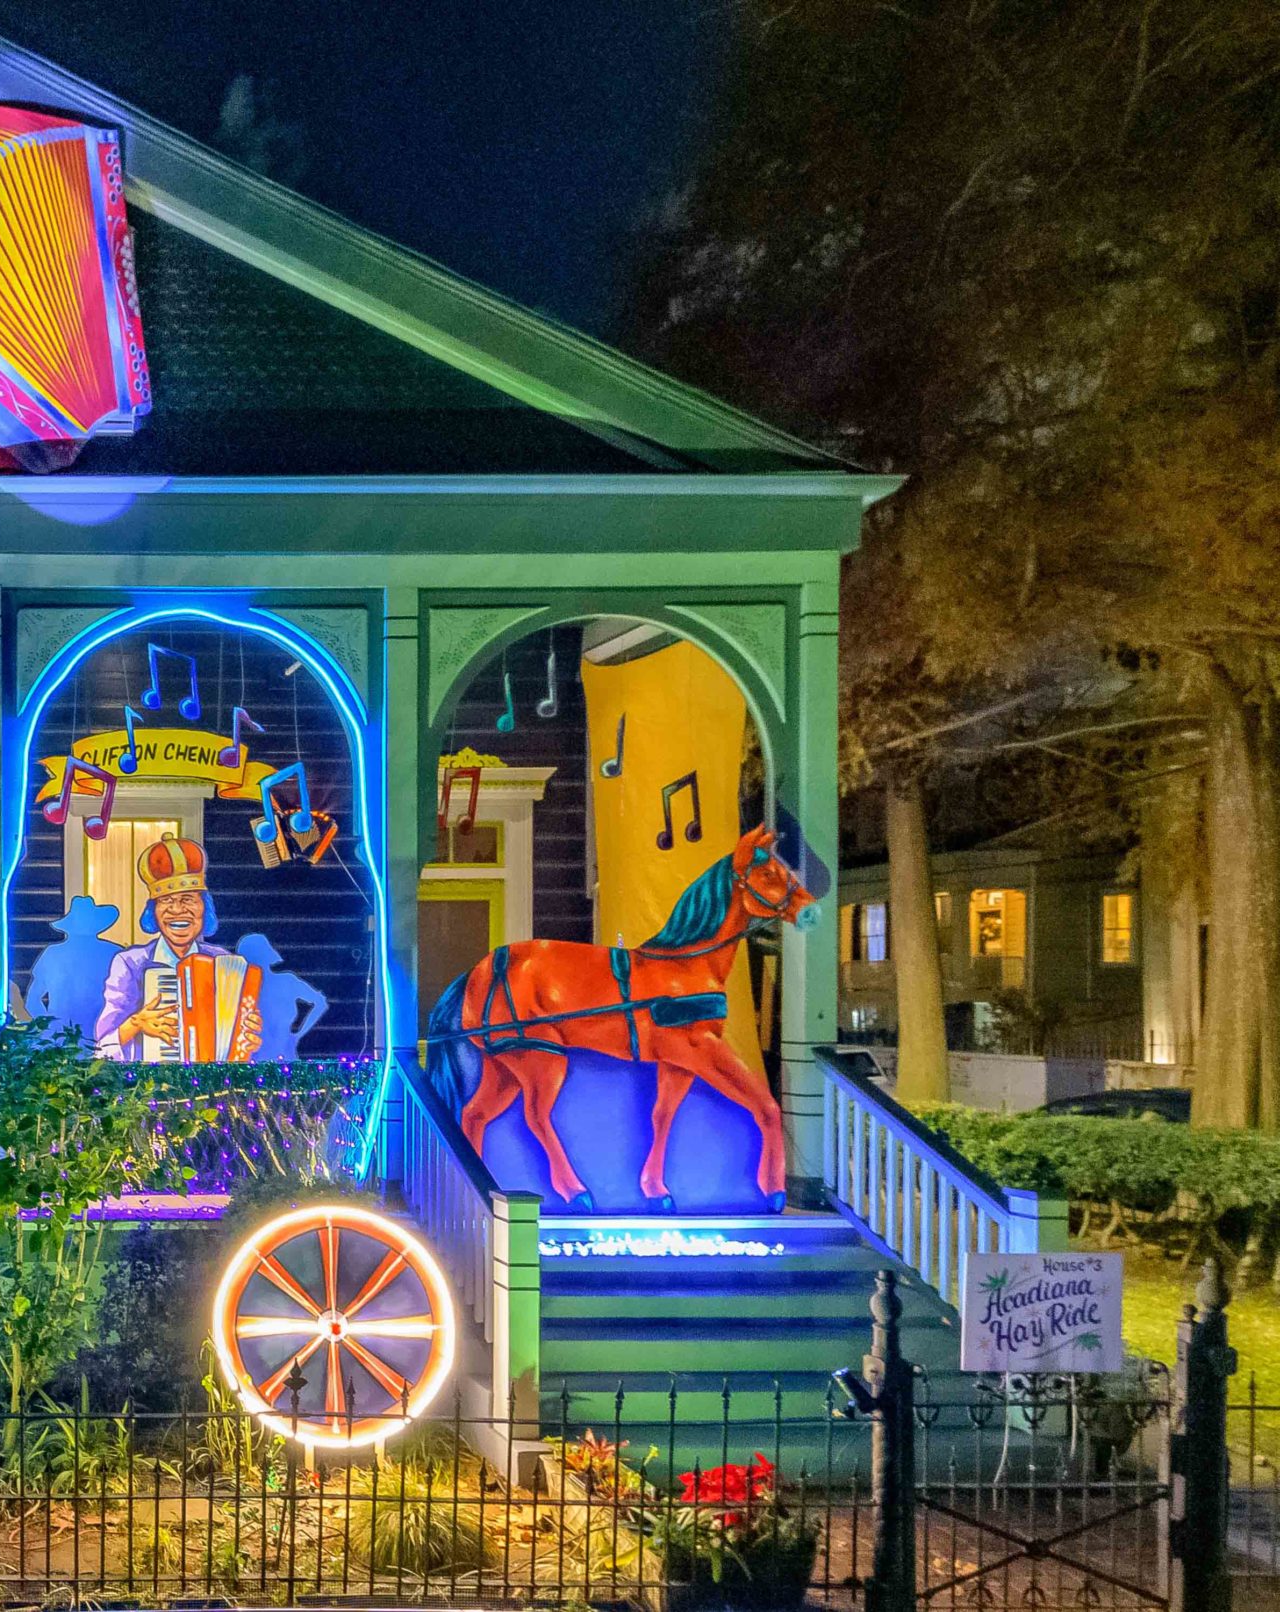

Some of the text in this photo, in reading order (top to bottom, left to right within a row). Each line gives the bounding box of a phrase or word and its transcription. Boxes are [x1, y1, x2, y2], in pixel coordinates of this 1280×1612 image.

[1043, 1258, 1085, 1275] House
[980, 1279, 1094, 1324] Acadiana
[990, 1298, 1101, 1352] Hay Ride
